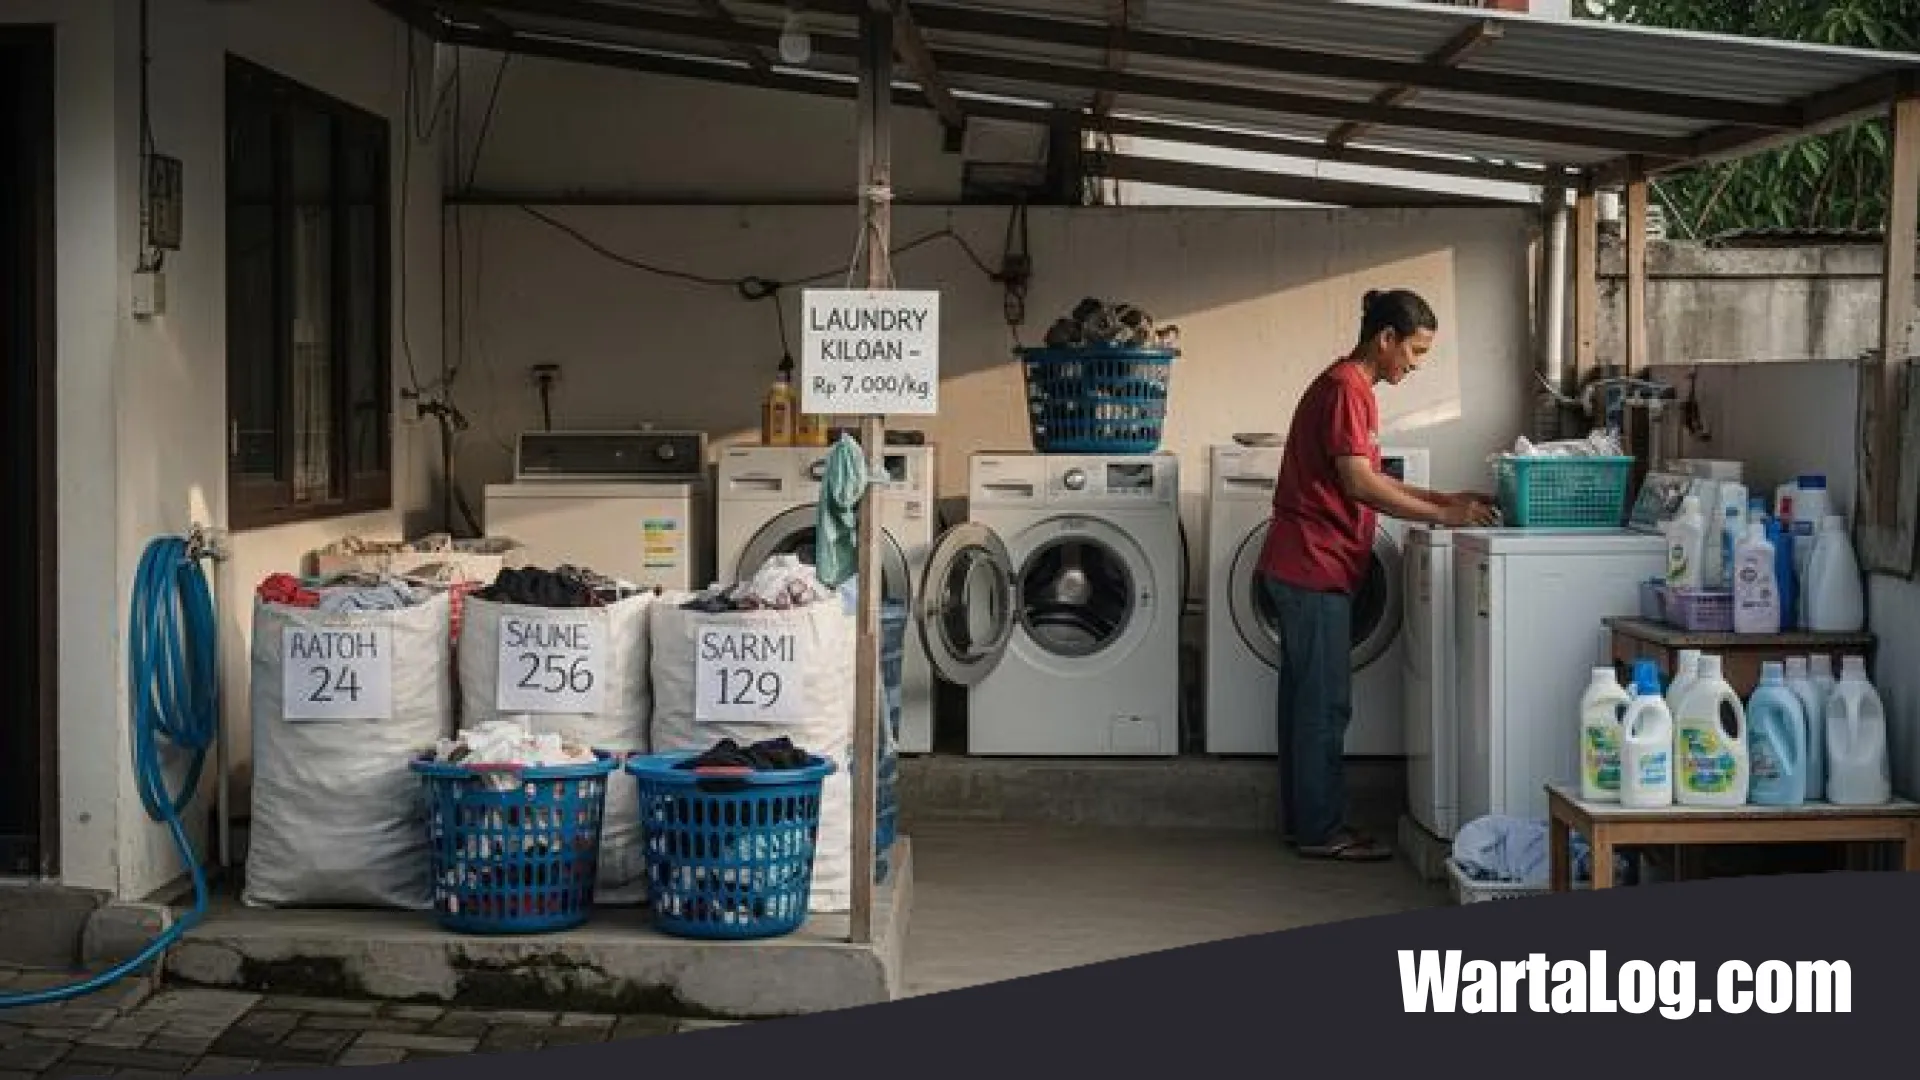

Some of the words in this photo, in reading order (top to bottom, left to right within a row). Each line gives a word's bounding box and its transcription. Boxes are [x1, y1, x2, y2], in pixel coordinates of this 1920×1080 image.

[810, 307, 928, 331] LAUNDRY
[821, 338, 902, 361] KILOAN
[812, 375, 837, 399] Rp
[841, 374, 929, 399] 7.000/kg
[701, 632, 795, 661] SARMI
[308, 665, 362, 701] 24
[517, 652, 594, 693] 256
[715, 667, 781, 708] 129
